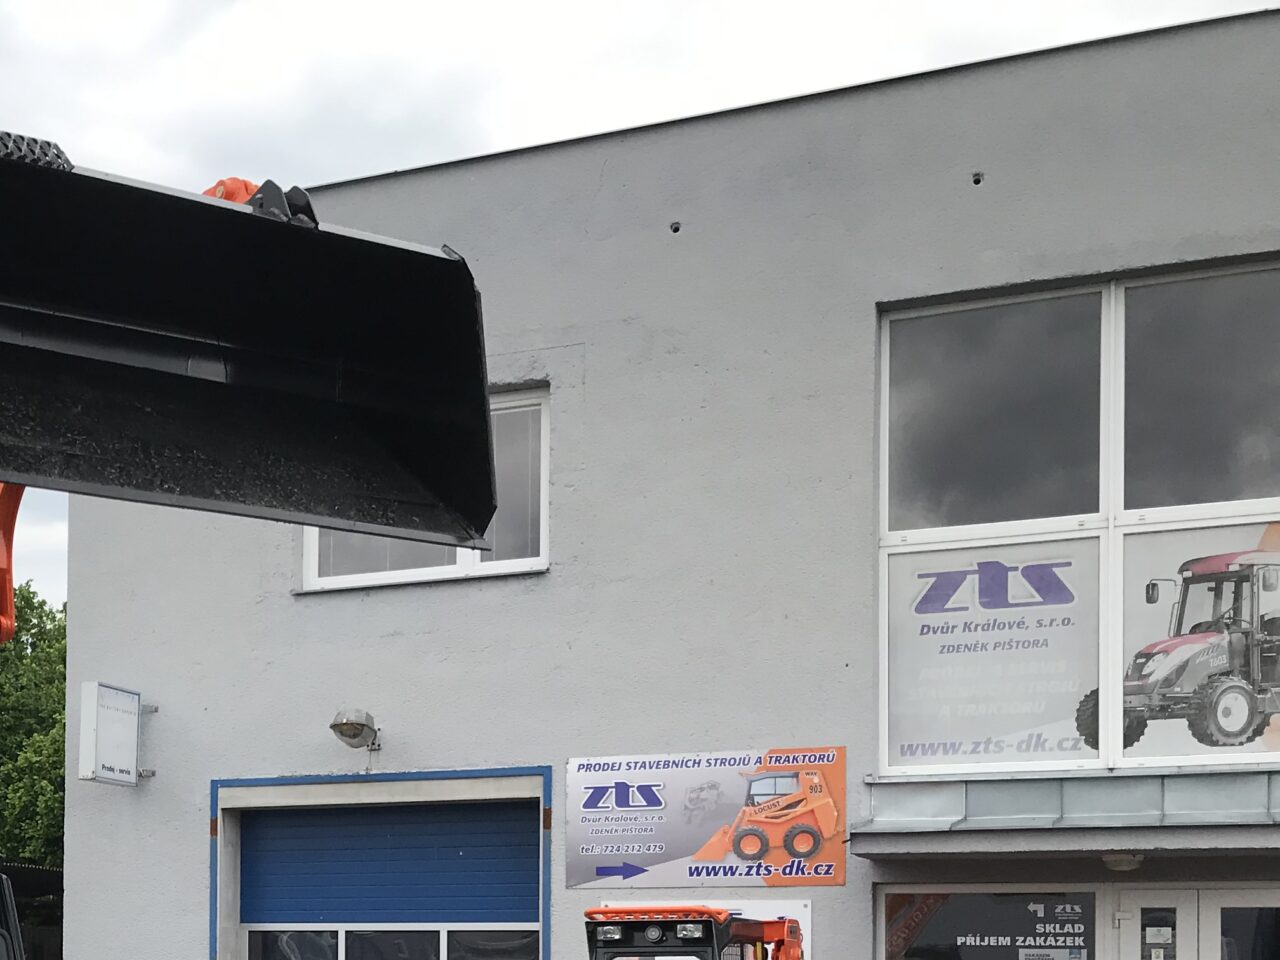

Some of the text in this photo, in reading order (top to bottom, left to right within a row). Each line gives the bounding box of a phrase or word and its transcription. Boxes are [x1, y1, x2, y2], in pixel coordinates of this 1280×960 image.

[919, 616, 1076, 636] Dvůr Králové, s.r.o.
[938, 638, 1049, 655] ZDENĚK PIŠTORA
[899, 733, 1084, 757] www.zts-dk.cz
[576, 751, 836, 773] PRODEJ STAVEBNÍCH STROJŮ A TRAKTORŮ
[753, 800, 781, 815] LOCUST
[621, 826, 654, 834] PIŠTORA
[580, 844, 664, 854] tel.: 724 212 479
[687, 860, 835, 878] www.zts-dk.cz
[1035, 923, 1085, 933] SKLAD
[956, 933, 1086, 946] PŘÍJEM ZAKÁZEK
